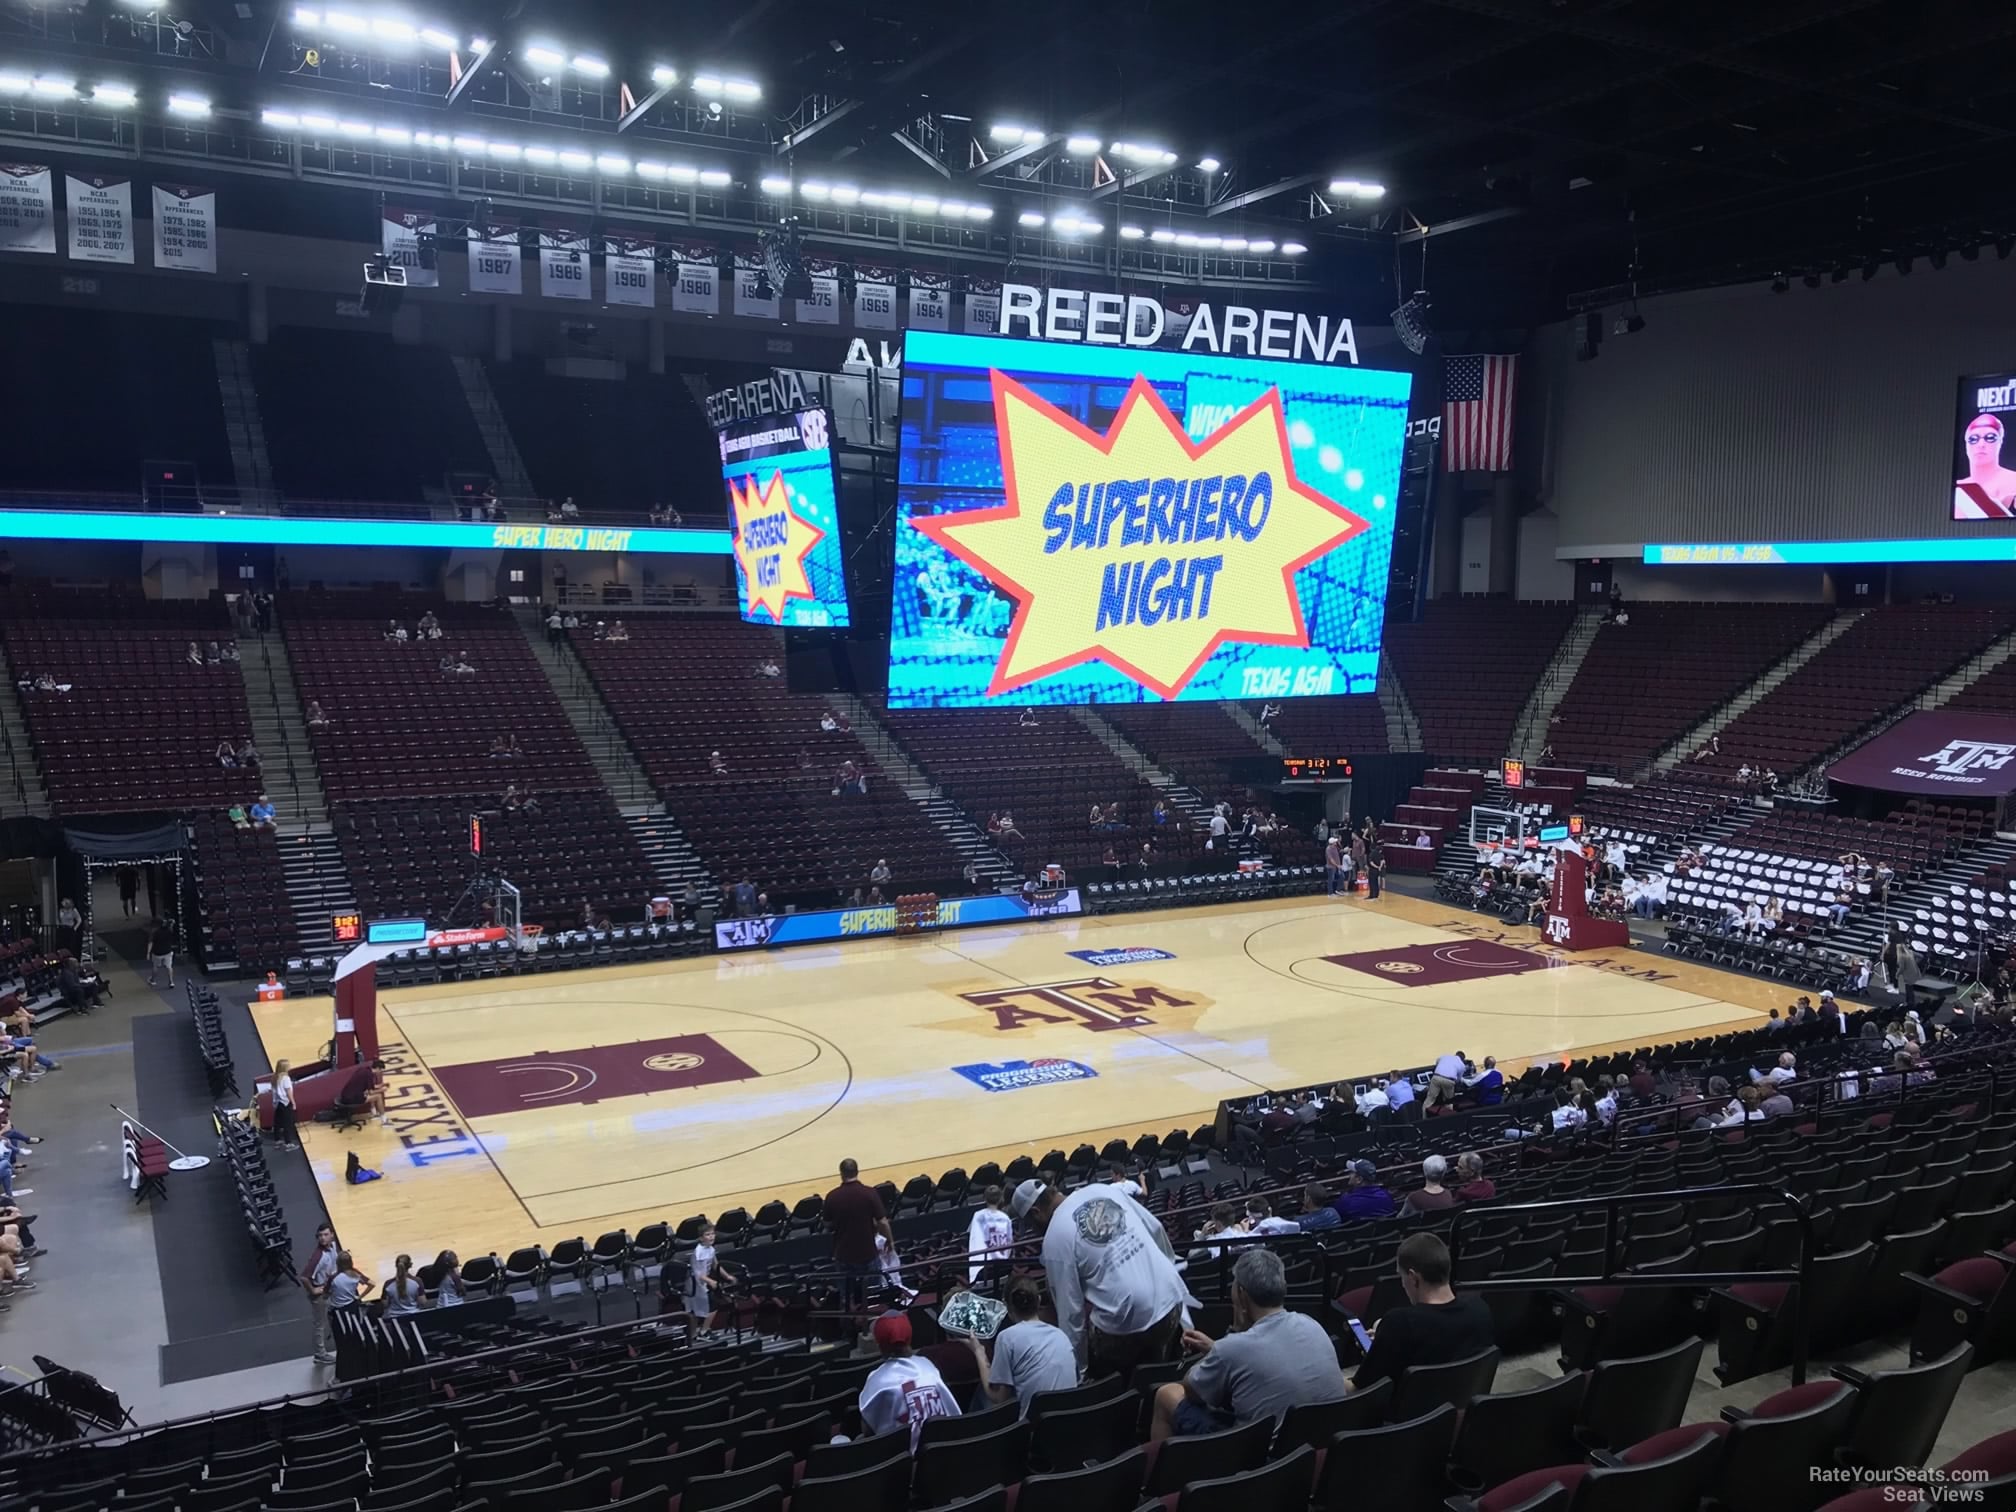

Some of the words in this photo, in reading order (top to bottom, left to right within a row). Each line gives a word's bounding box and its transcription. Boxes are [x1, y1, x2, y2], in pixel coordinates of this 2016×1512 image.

[392, 250, 420, 268] 201
[478, 258, 513, 274] 1987
[549, 263, 582, 280] 1986
[614, 271, 647, 288] 1980
[680, 279, 711, 295] 1980
[861, 297, 889, 313] 1969
[916, 303, 944, 319] 1964
[999, 283, 1164, 346] REED
[1181, 303, 1359, 365] ARENA
[736, 372, 807, 420] ARENA
[1977, 386, 2011, 408] NEXT
[1043, 471, 1273, 555] SUPERHERO
[493, 525, 541, 548] SUPER
[544, 527, 584, 550] HERO
[586, 528, 633, 551] NIGHT
[744, 511, 788, 554] SUPERHERO
[1096, 554, 1223, 632] NIGHT
[1241, 667, 1292, 697] TEXAS
[1291, 666, 1334, 696] A&M
[1891, 767, 1927, 778] REED
[1925, 773, 1987, 784] ROWDIES
[337, 926, 355, 940] 30
[980, 1062, 1074, 1081] PROGRESSIVE
[985, 1067, 1085, 1088] LEGENDS
